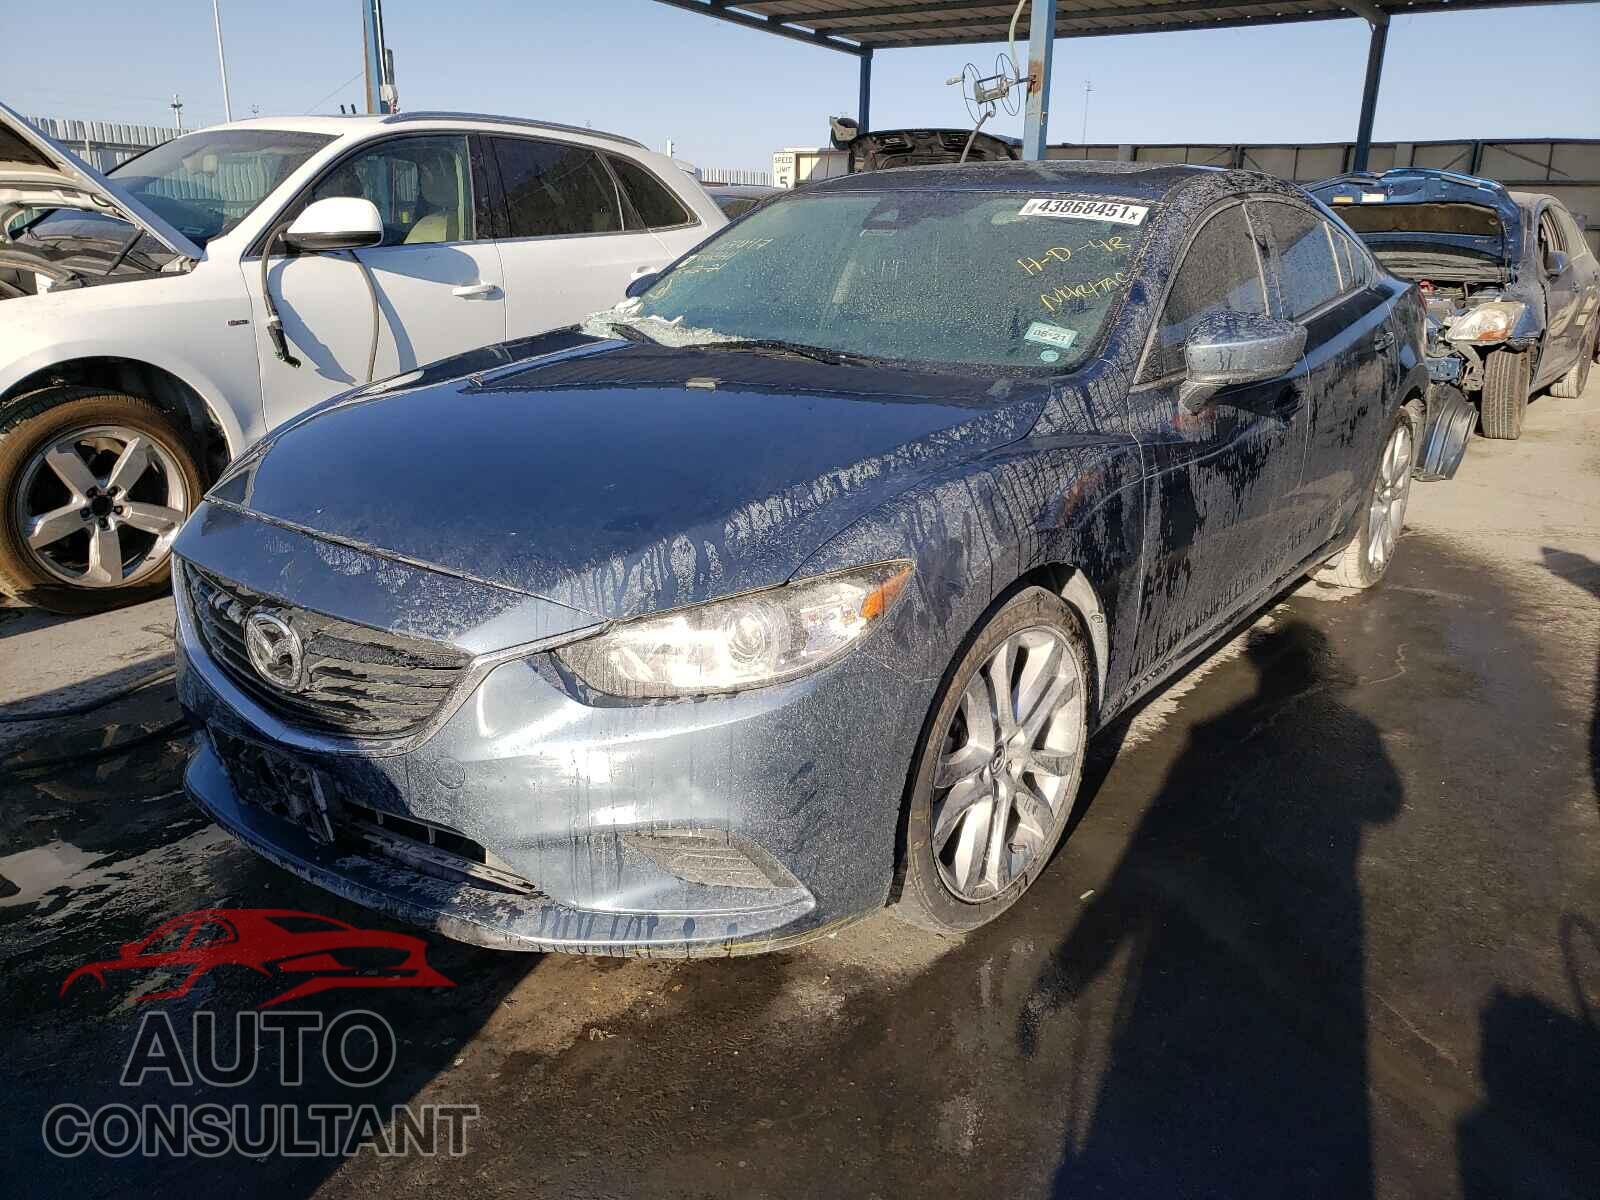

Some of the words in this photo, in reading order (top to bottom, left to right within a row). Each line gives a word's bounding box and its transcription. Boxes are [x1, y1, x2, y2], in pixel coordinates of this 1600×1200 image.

[774, 156, 793, 164] SPEED
[780, 176, 788, 188] 5
[1038, 200, 1130, 219] 43868451
